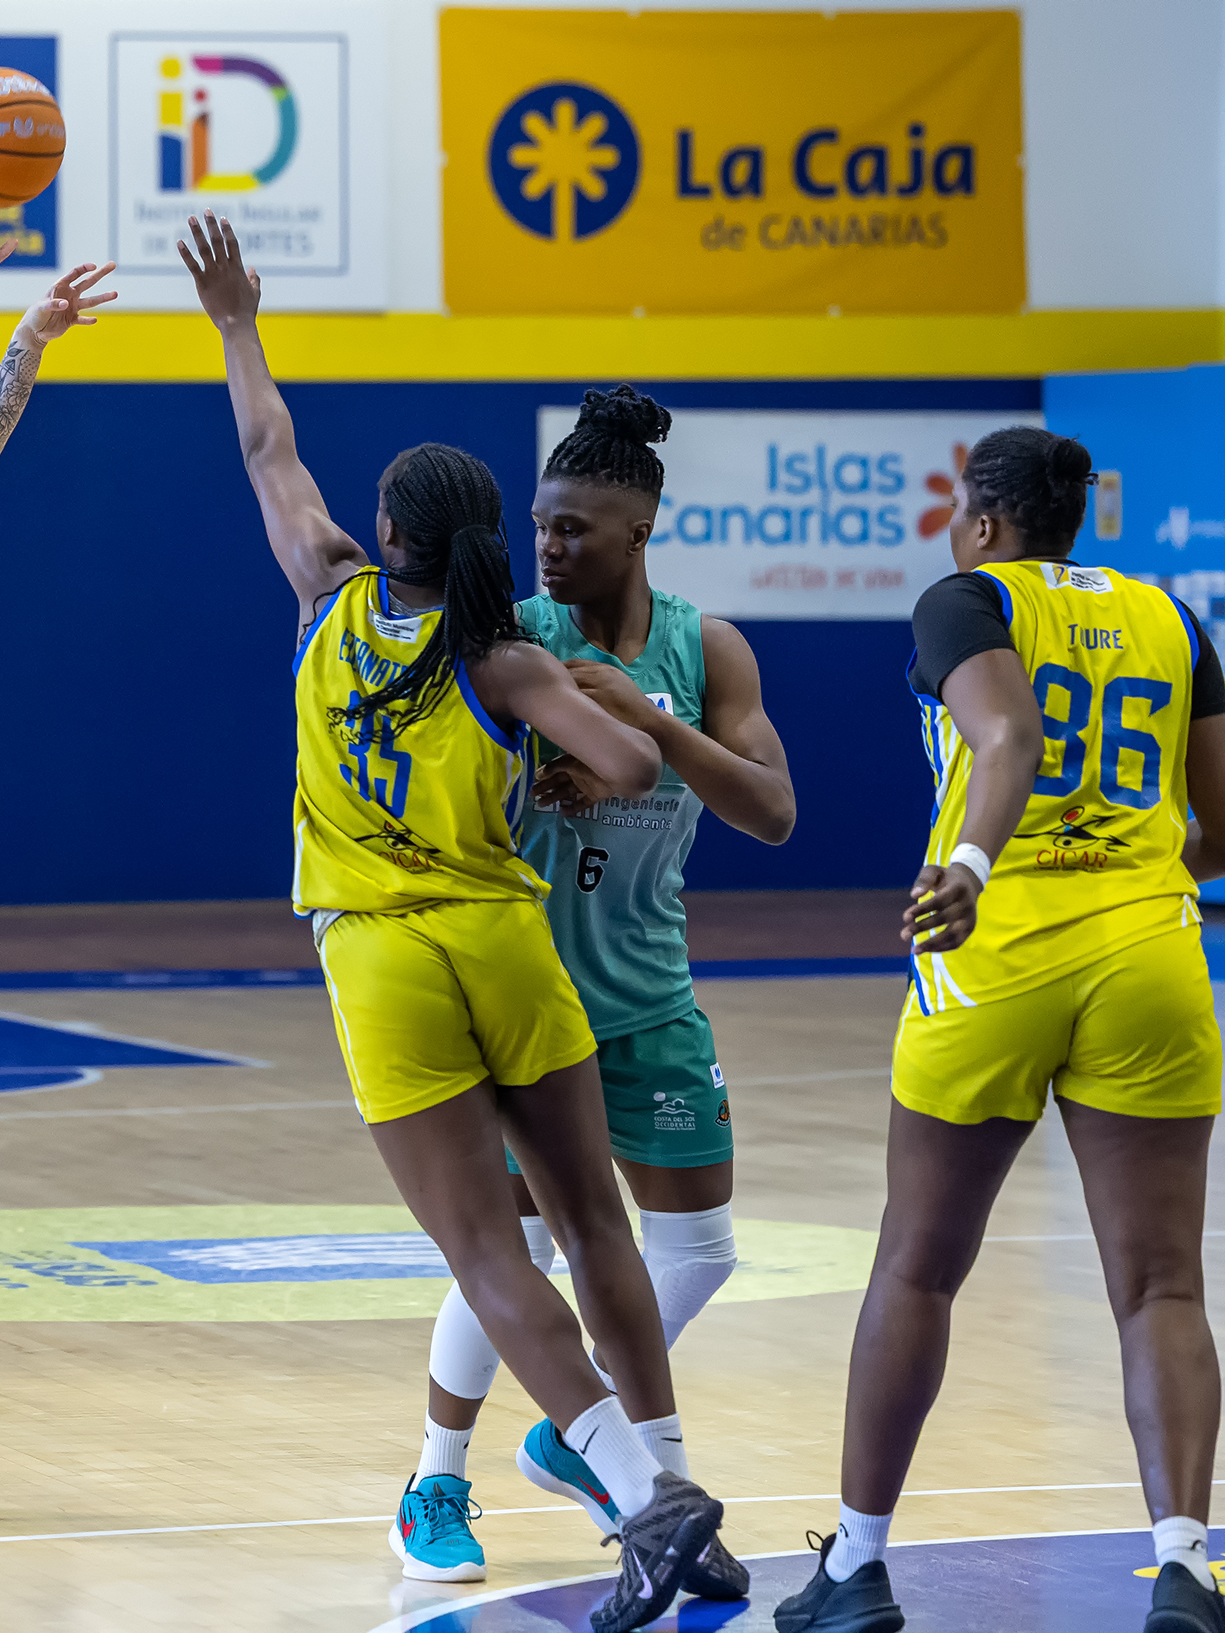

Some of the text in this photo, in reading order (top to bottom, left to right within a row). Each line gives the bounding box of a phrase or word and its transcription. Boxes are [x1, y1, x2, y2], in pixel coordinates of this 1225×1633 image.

[676, 122, 977, 200] La Caja
[700, 210, 949, 251] de CANARIAS
[766, 442, 906, 497] Islas
[1032, 662, 1173, 811] 86
[576, 845, 610, 894] 6
[1037, 849, 1108, 868] CICAR
